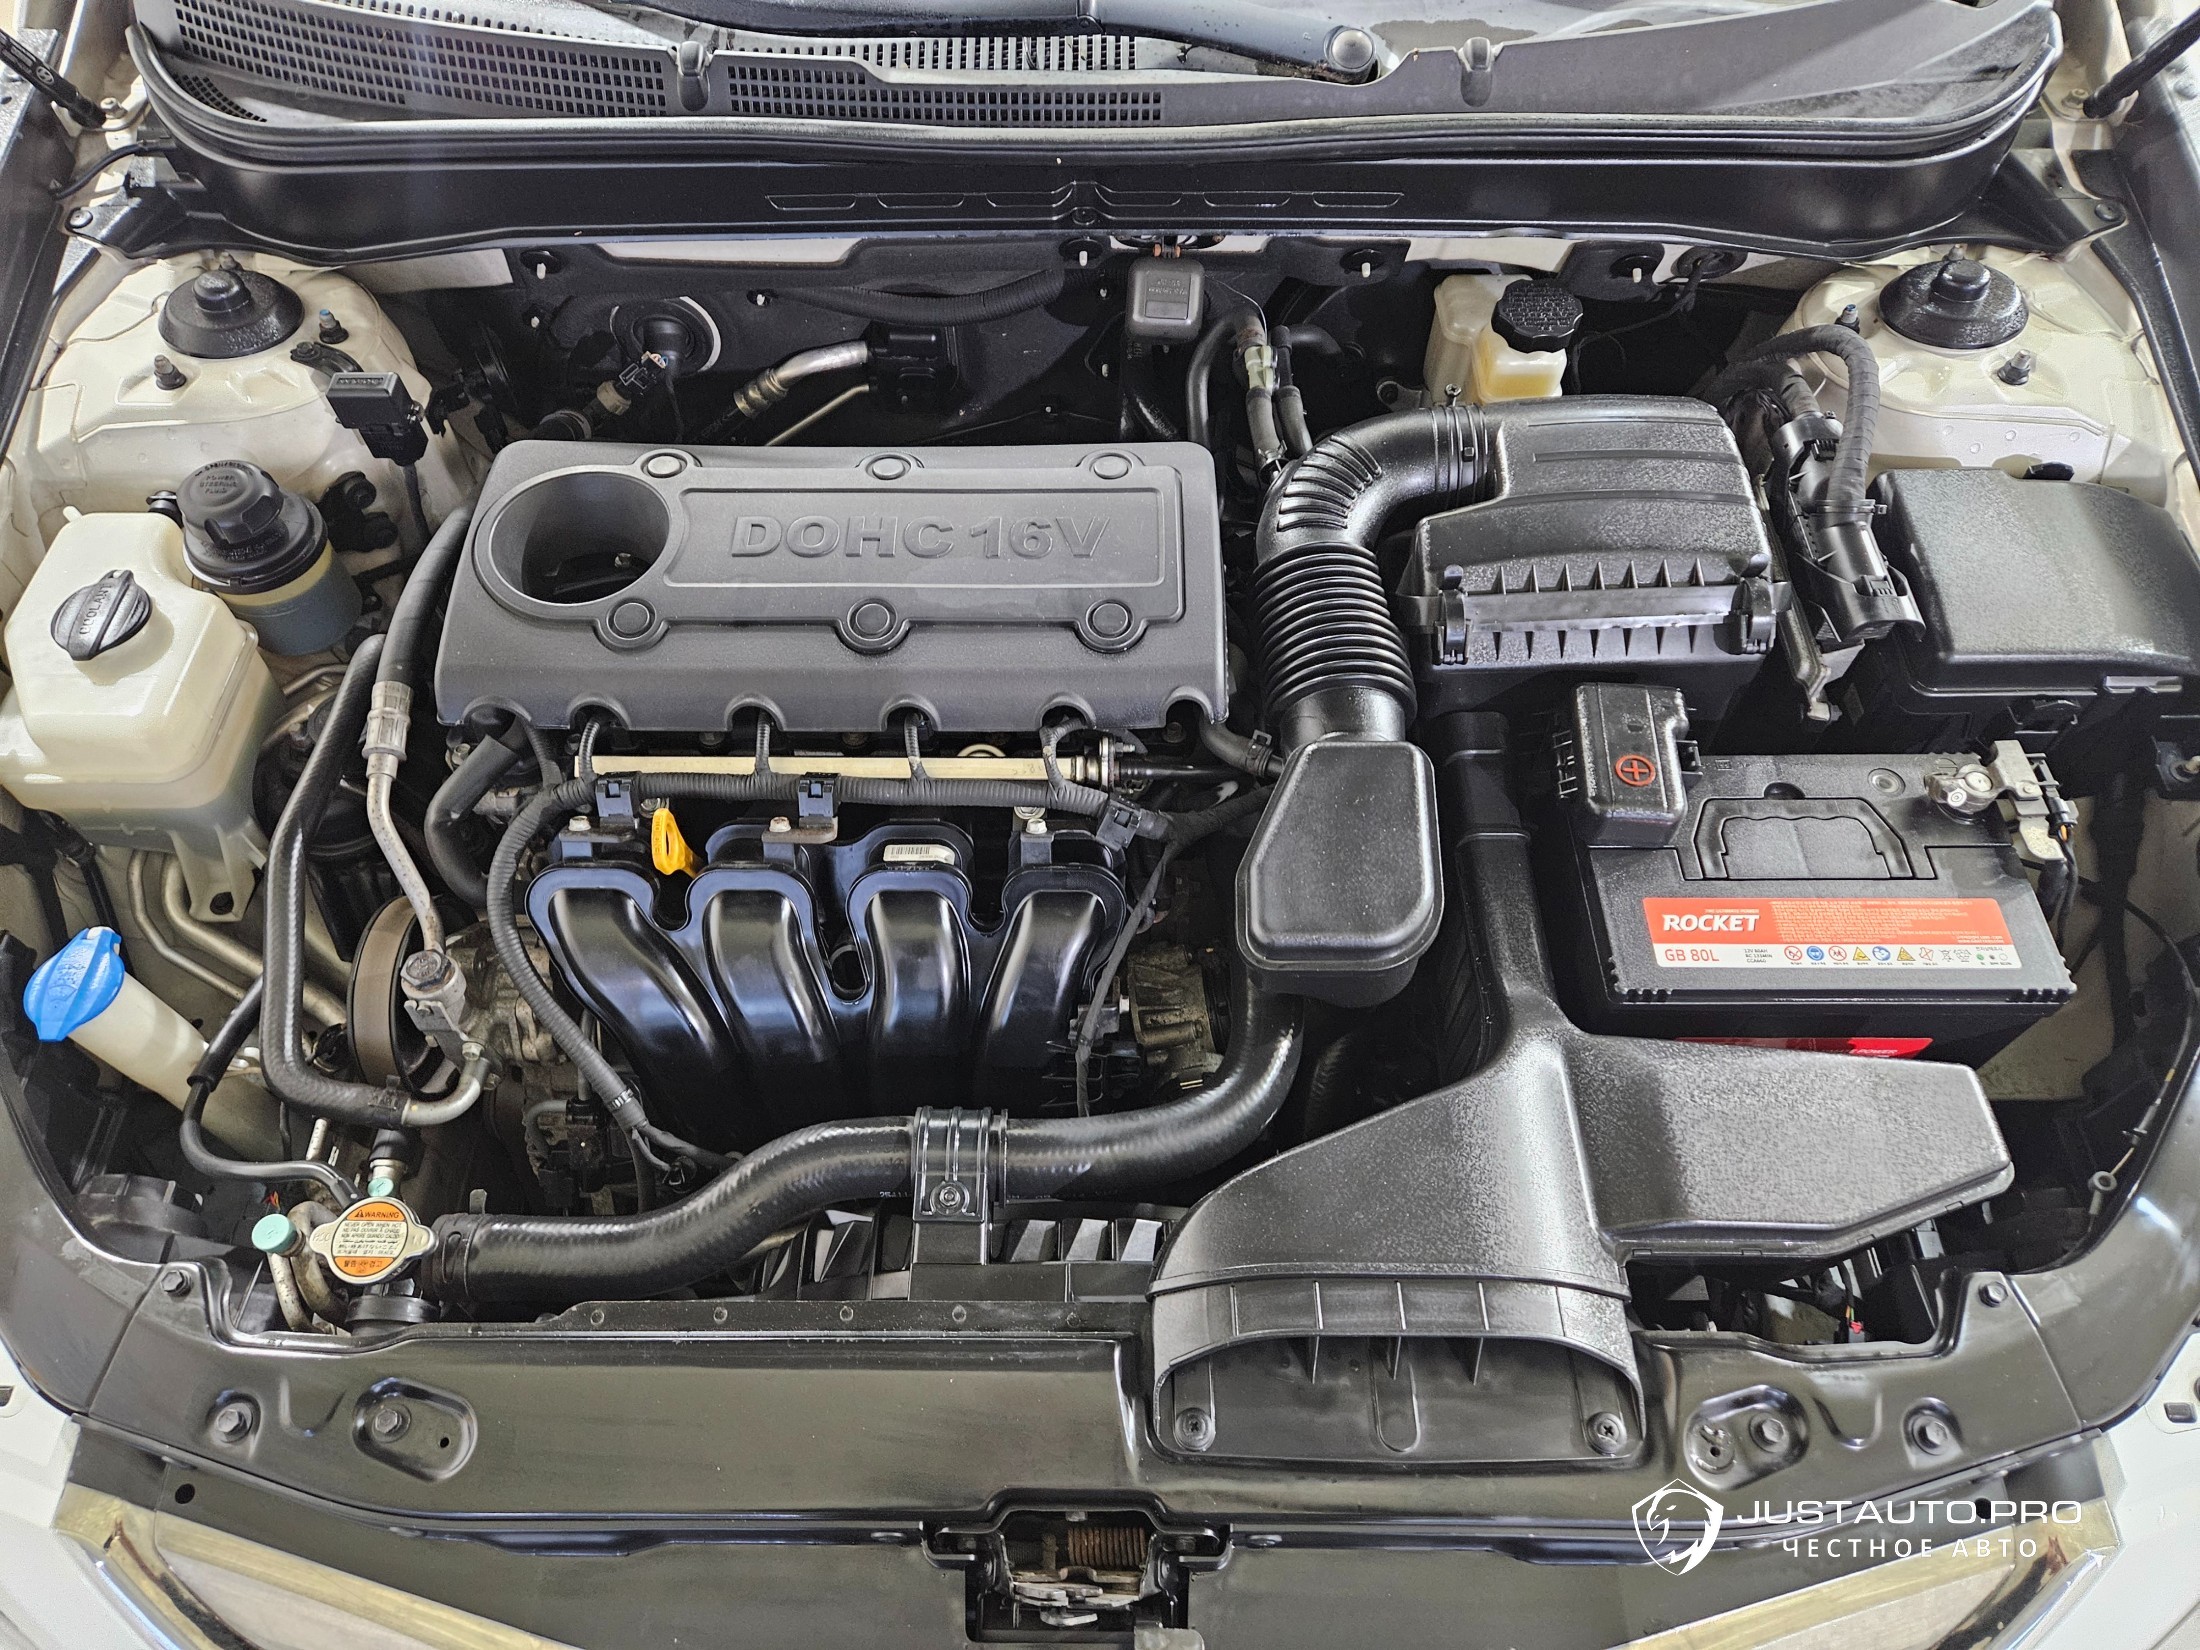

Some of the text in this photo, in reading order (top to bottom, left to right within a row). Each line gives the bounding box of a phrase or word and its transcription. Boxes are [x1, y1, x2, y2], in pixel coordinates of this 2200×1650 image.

[731, 515, 1111, 559] DOHC 16V
[80, 584, 112, 635] COOLANT
[1662, 914, 1760, 932] ROCKET
[1664, 949, 1719, 962] GB 80L
[364, 1210, 400, 1219] WARNING
